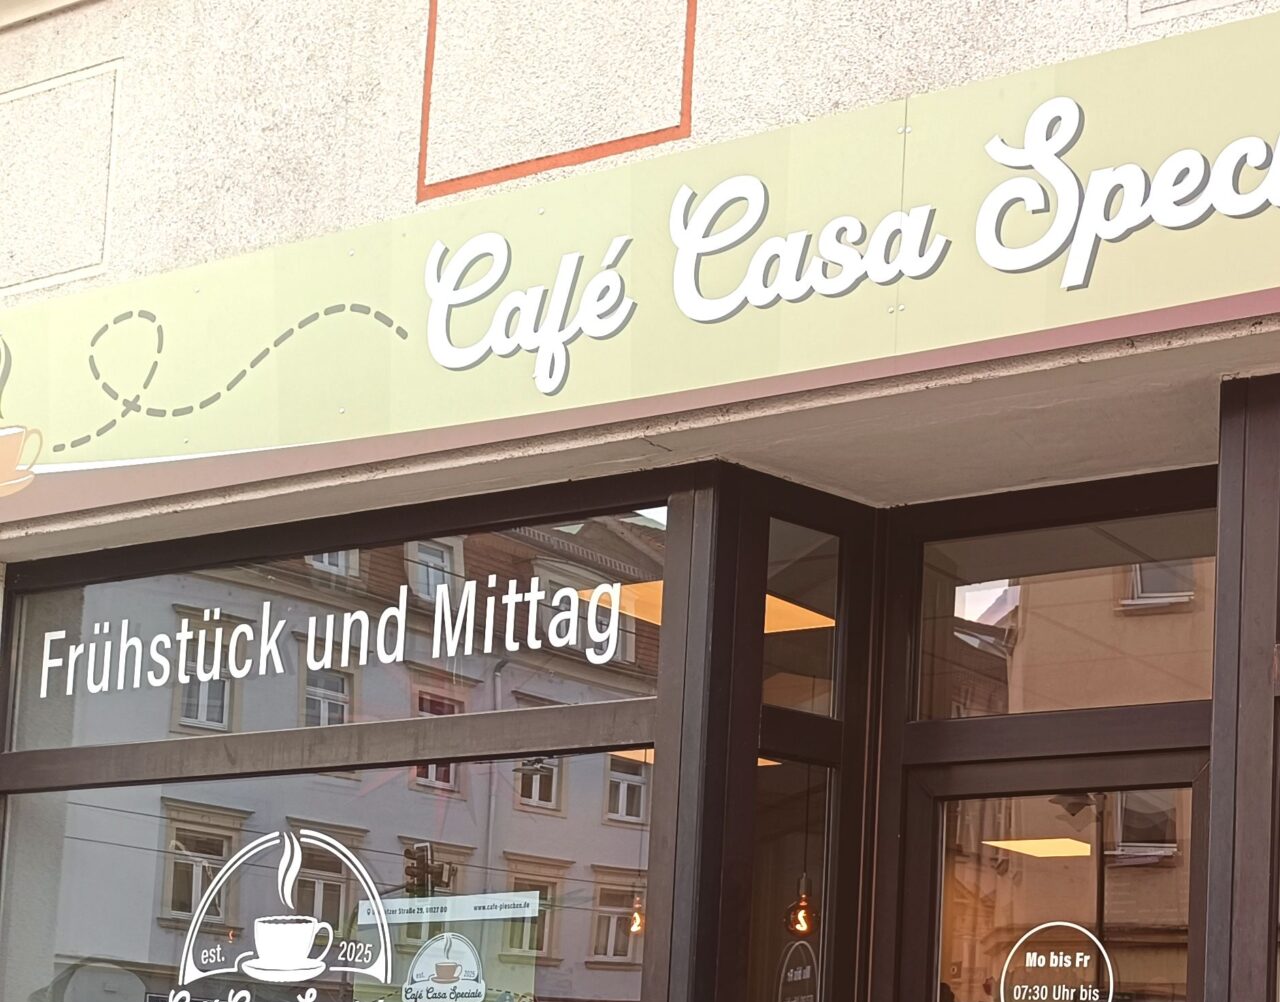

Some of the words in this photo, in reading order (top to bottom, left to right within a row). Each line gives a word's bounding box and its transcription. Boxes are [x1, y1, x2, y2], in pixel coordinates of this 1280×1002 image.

[423, 231, 636, 396] Café
[669, 175, 950, 325] Casa
[39, 600, 287, 699] Frühstück
[306, 585, 408, 671] und
[431, 573, 622, 665] Mittag
[201, 944, 225, 965] est.
[338, 941, 373, 963] 2025
[1025, 952, 1046, 968] Mo
[1049, 951, 1072, 968] bis
[1075, 952, 1091, 968] Fr
[404, 987, 424, 1001] Café
[426, 986, 448, 1000] Casa
[449, 986, 483, 1002] Speciale
[1013, 984, 1049, 1001] 07:30
[1052, 984, 1076, 1001] Uhr
[1079, 984, 1100, 1001] bis
